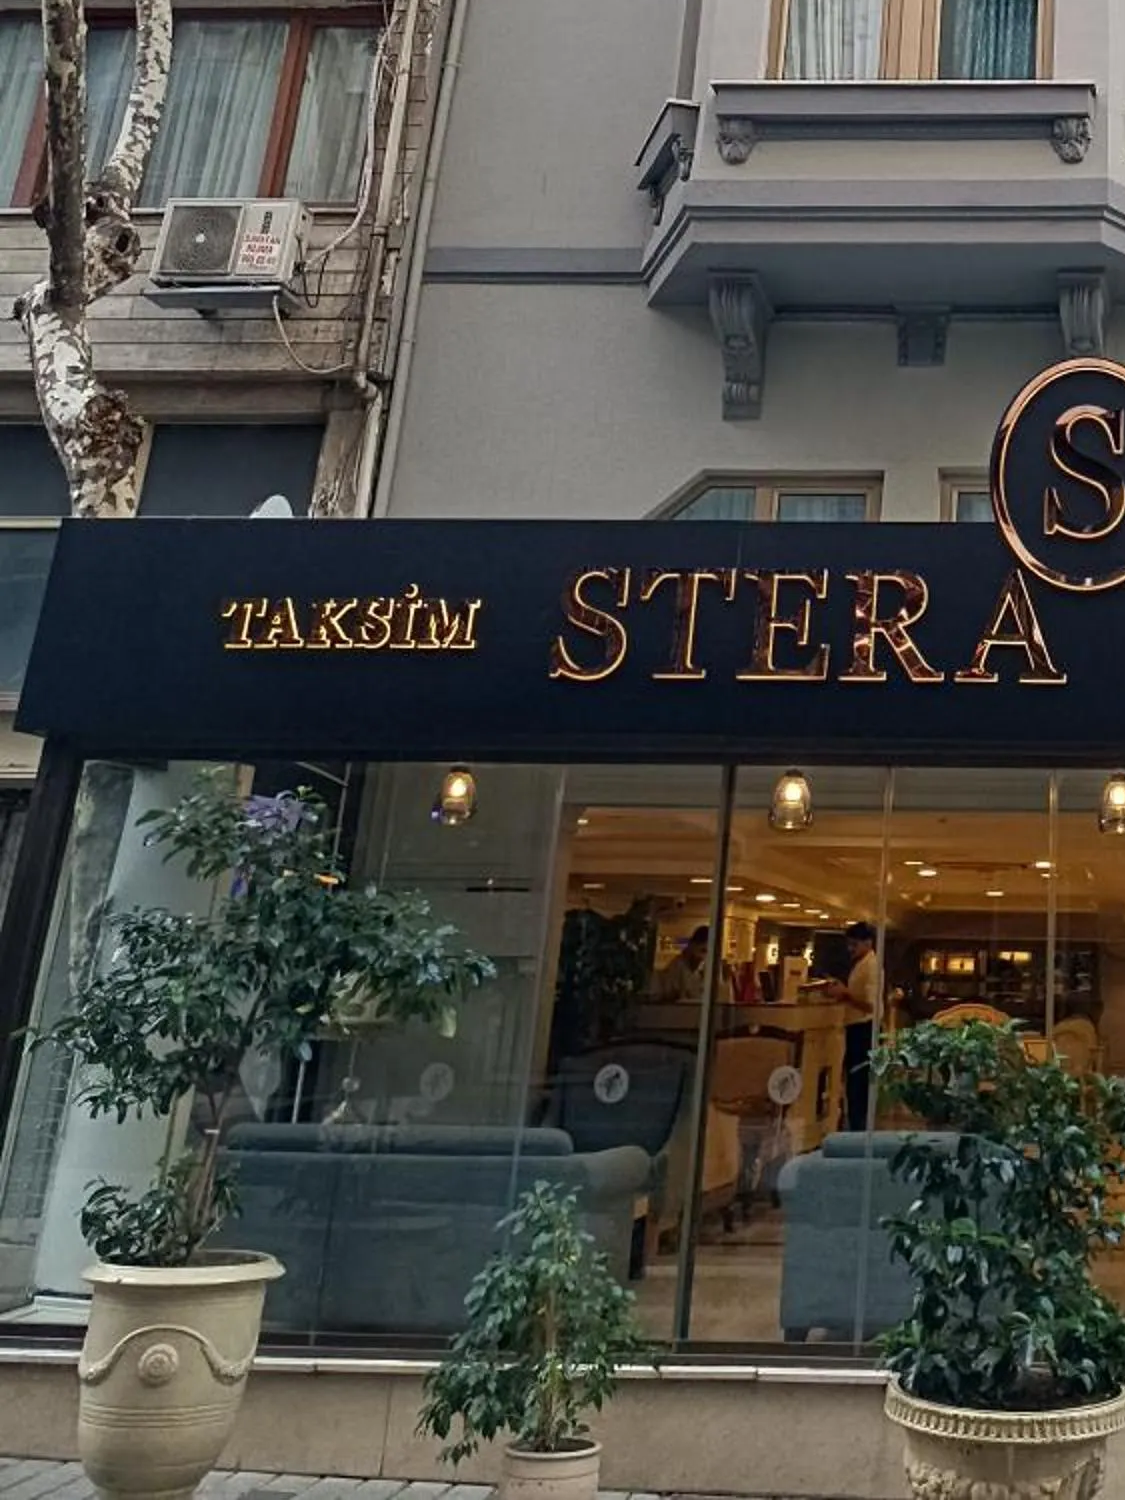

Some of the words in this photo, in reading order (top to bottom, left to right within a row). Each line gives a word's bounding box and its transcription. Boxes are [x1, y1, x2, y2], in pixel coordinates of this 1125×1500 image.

[1043, 404, 1125, 541] S
[221, 583, 483, 651] TAKSİM
[548, 565, 1068, 687] STERA
